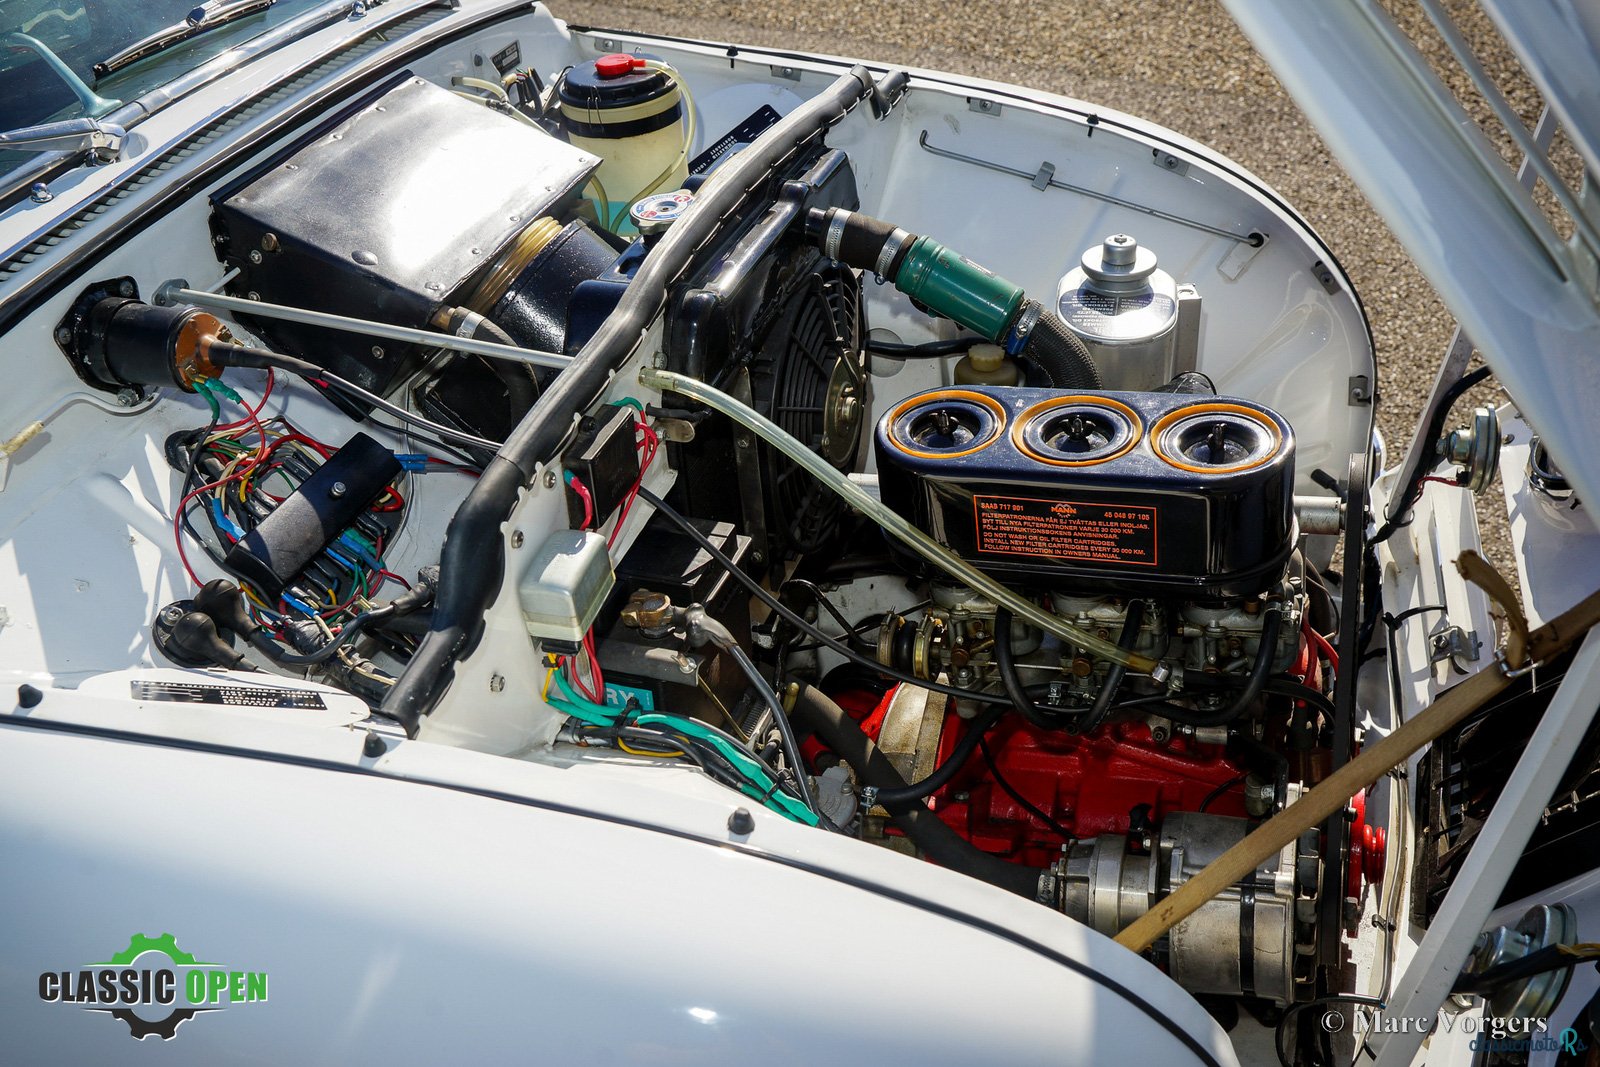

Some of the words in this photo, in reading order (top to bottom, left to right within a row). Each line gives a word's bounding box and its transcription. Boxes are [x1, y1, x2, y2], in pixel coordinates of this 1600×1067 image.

[999, 503, 1011, 511] 717
[982, 513, 1044, 522] FILTERPATRONERNA
[1011, 546, 1053, 554] INSTRUCTION
[1048, 542, 1089, 550] CARTRIDGES
